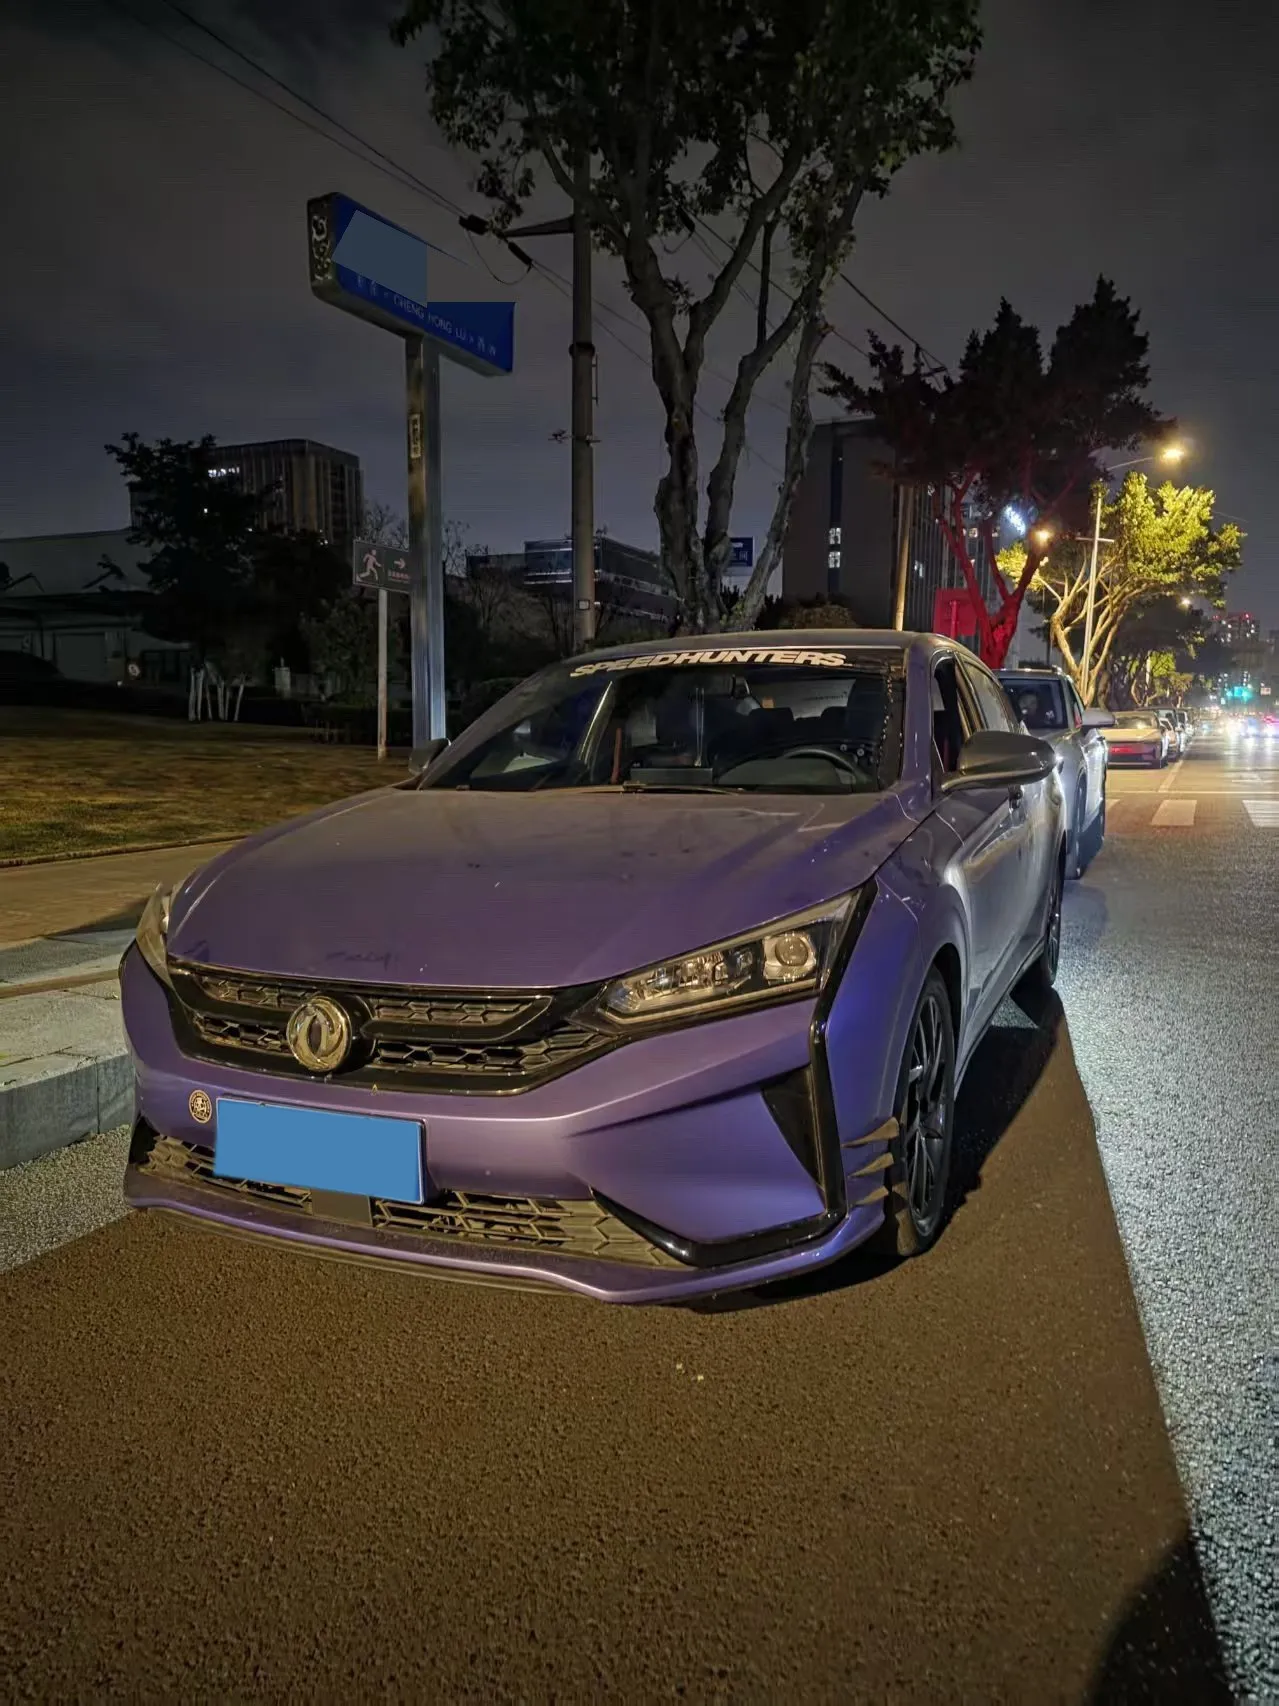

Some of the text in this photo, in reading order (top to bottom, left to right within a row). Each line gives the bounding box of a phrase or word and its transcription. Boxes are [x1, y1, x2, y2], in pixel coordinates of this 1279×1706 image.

[393, 294, 424, 320] CHENG
[428, 311, 452, 334] HONG
[570, 650, 847, 678] SPEEDHUNTERS
